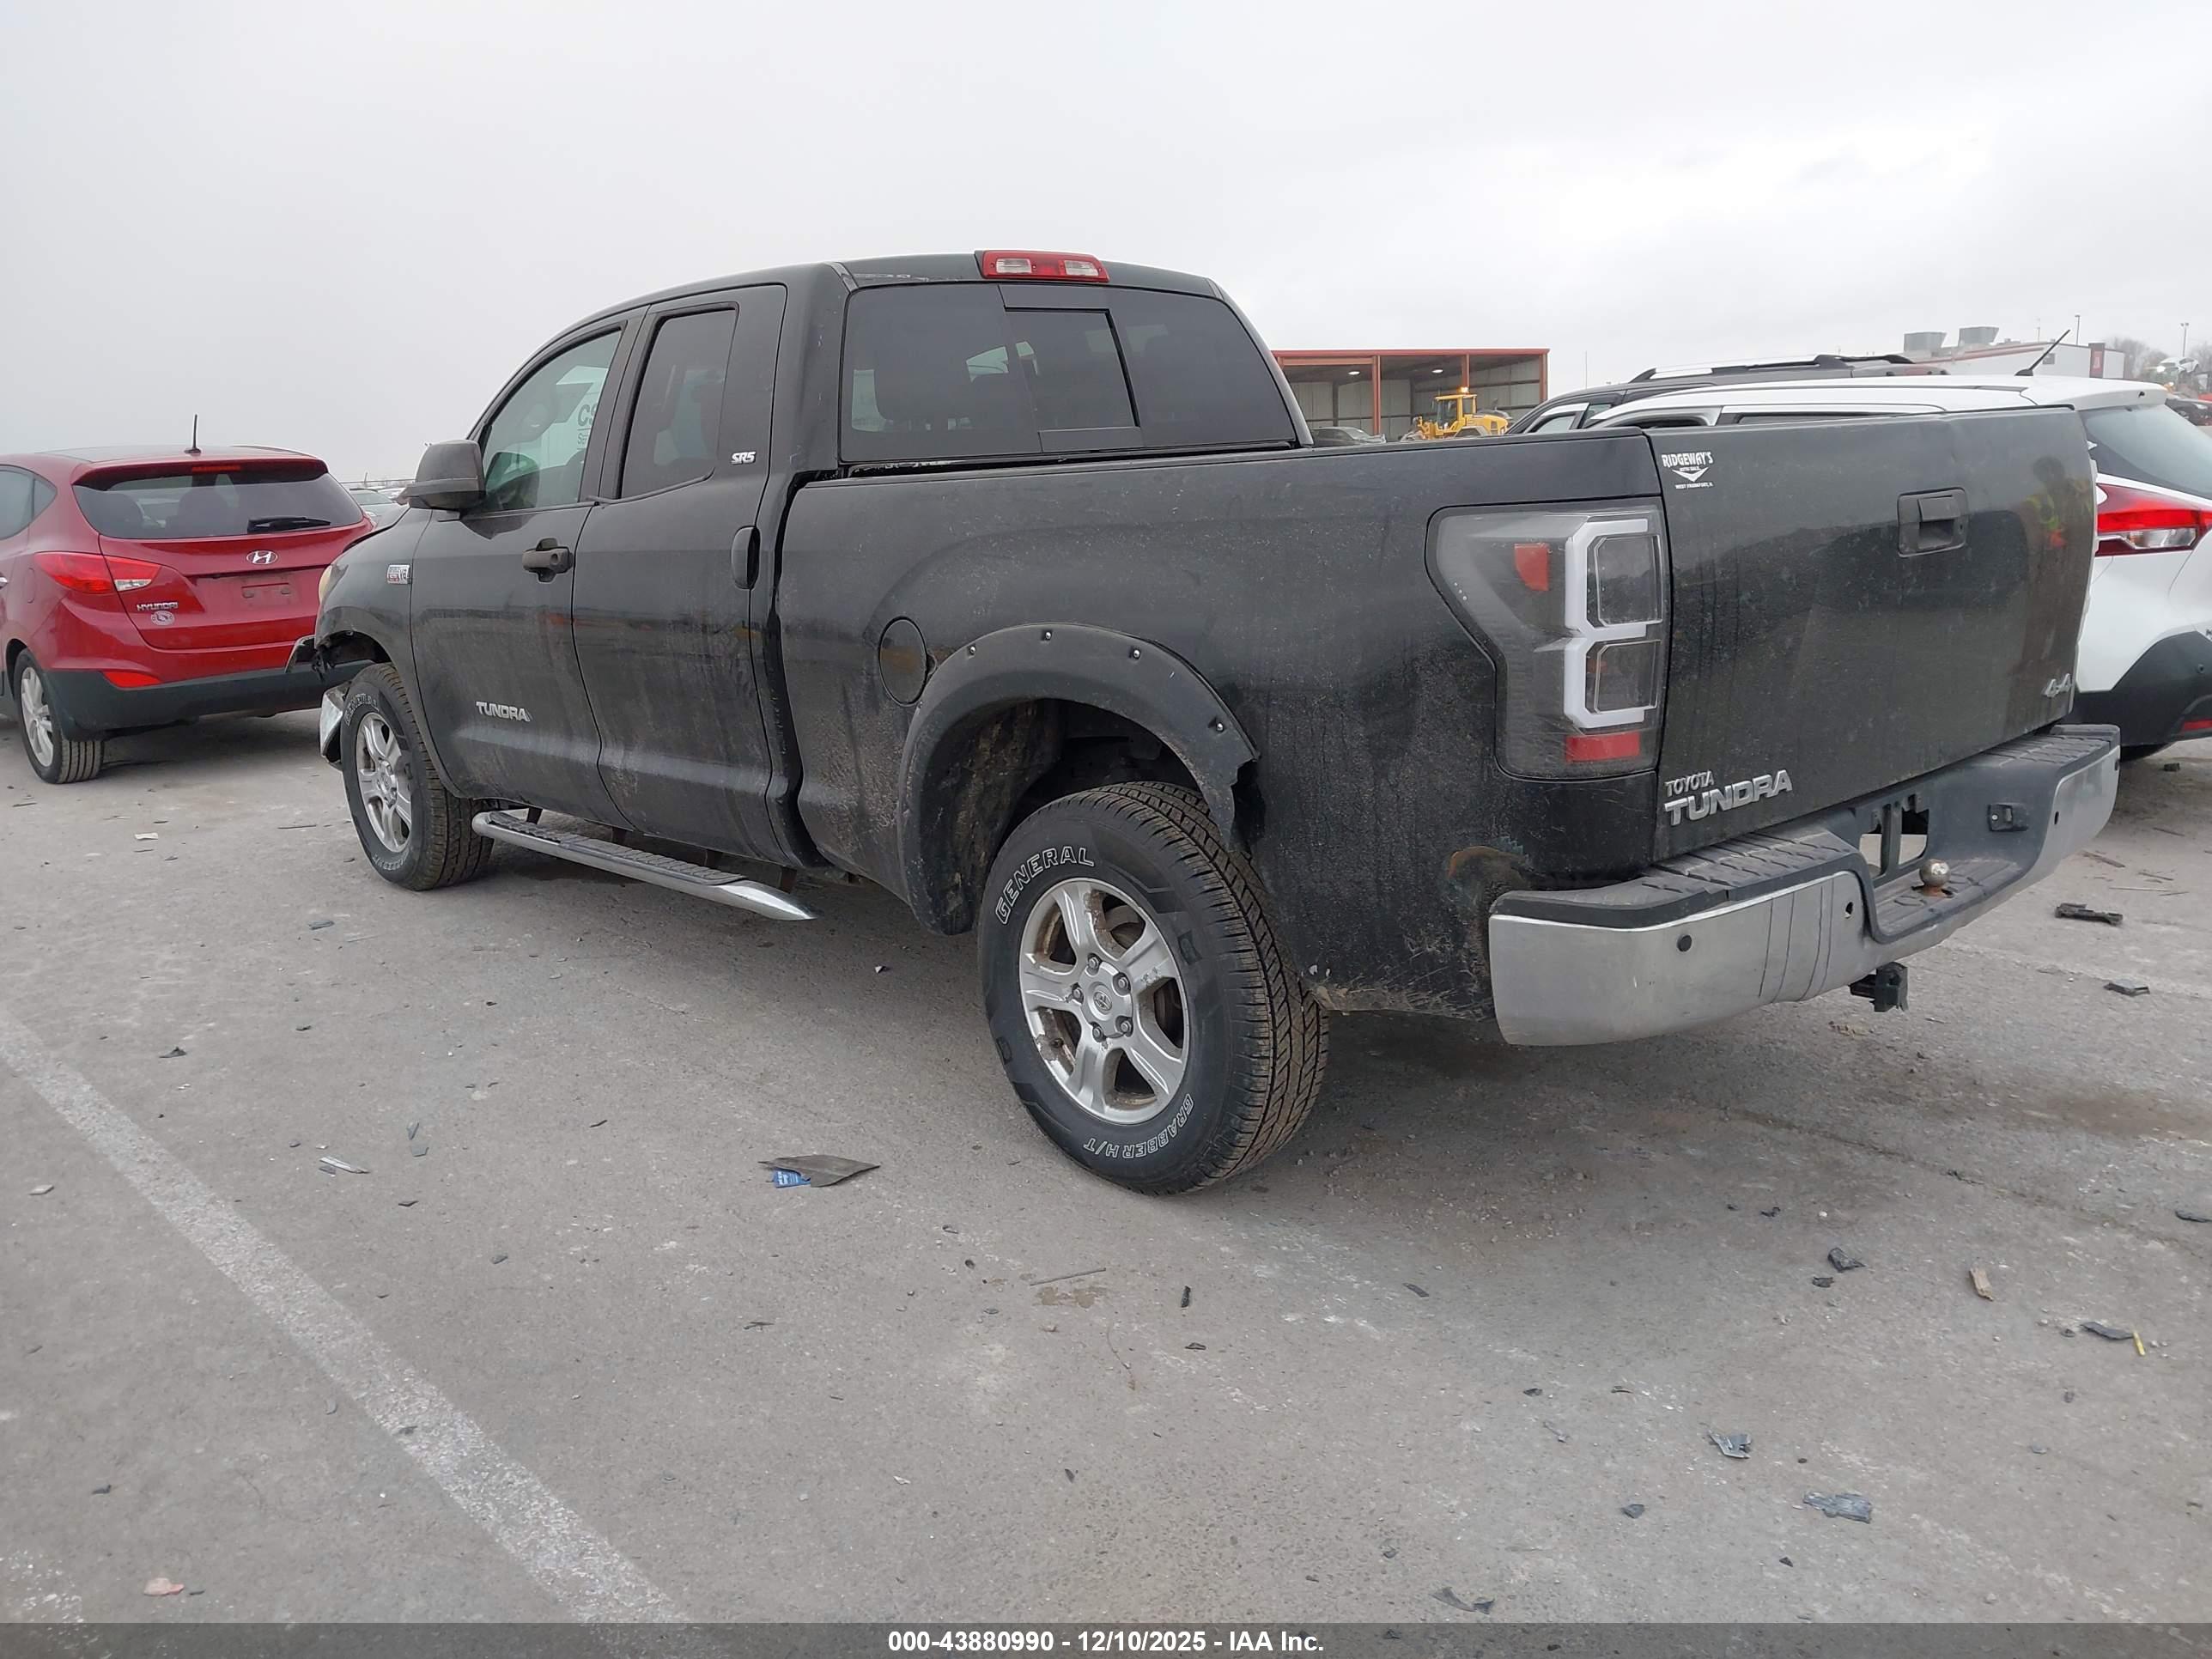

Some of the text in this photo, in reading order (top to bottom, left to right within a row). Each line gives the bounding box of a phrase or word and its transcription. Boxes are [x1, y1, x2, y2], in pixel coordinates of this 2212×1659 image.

[731, 451, 756, 465] SR5
[1662, 452, 1714, 468] RIDGEWAY'S
[137, 602, 179, 611] HYUNDAI
[476, 701, 532, 722] TUNDRA
[1664, 769, 1715, 797] TOYOTA
[1664, 769, 1793, 826] TUNDRA
[995, 846, 1095, 925] GENERAL
[1084, 1093, 1194, 1159] GRABBER H/T
